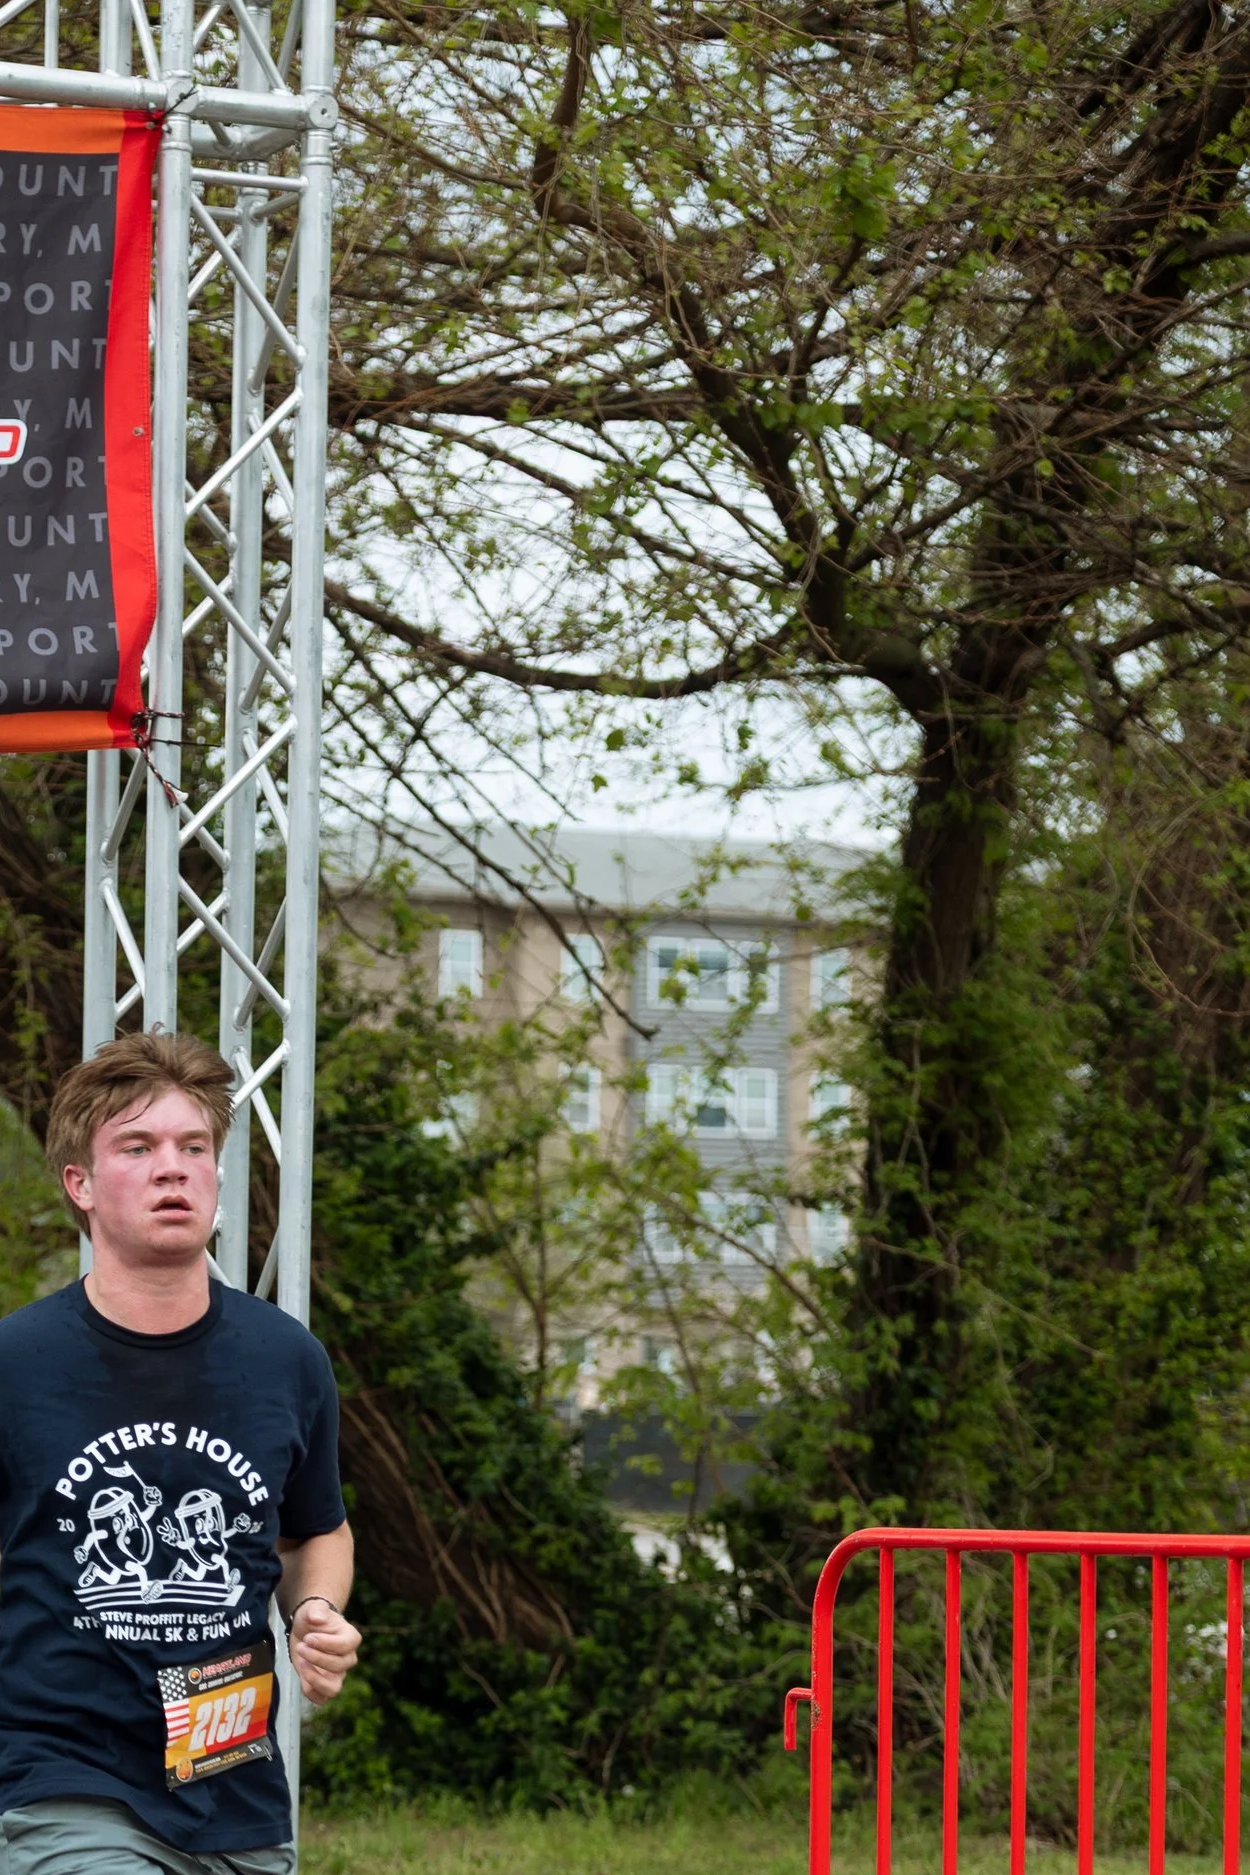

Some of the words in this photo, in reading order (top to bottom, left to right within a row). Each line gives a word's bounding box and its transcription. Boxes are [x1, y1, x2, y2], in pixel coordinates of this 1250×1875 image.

[54, 1421, 177, 1501] POTTER'S
[184, 1426, 270, 1508] HOUSE
[100, 1611, 133, 1624] STEVE
[135, 1612, 185, 1626] PROFFITT
[186, 1611, 226, 1625] LEGACY
[104, 1624, 161, 1641] NNUAL
[164, 1626, 184, 1643] 5K
[186, 1627, 199, 1642] &
[201, 1622, 232, 1641] FUN
[232, 1610, 252, 1628] UN
[187, 1686, 258, 1752] 2132
